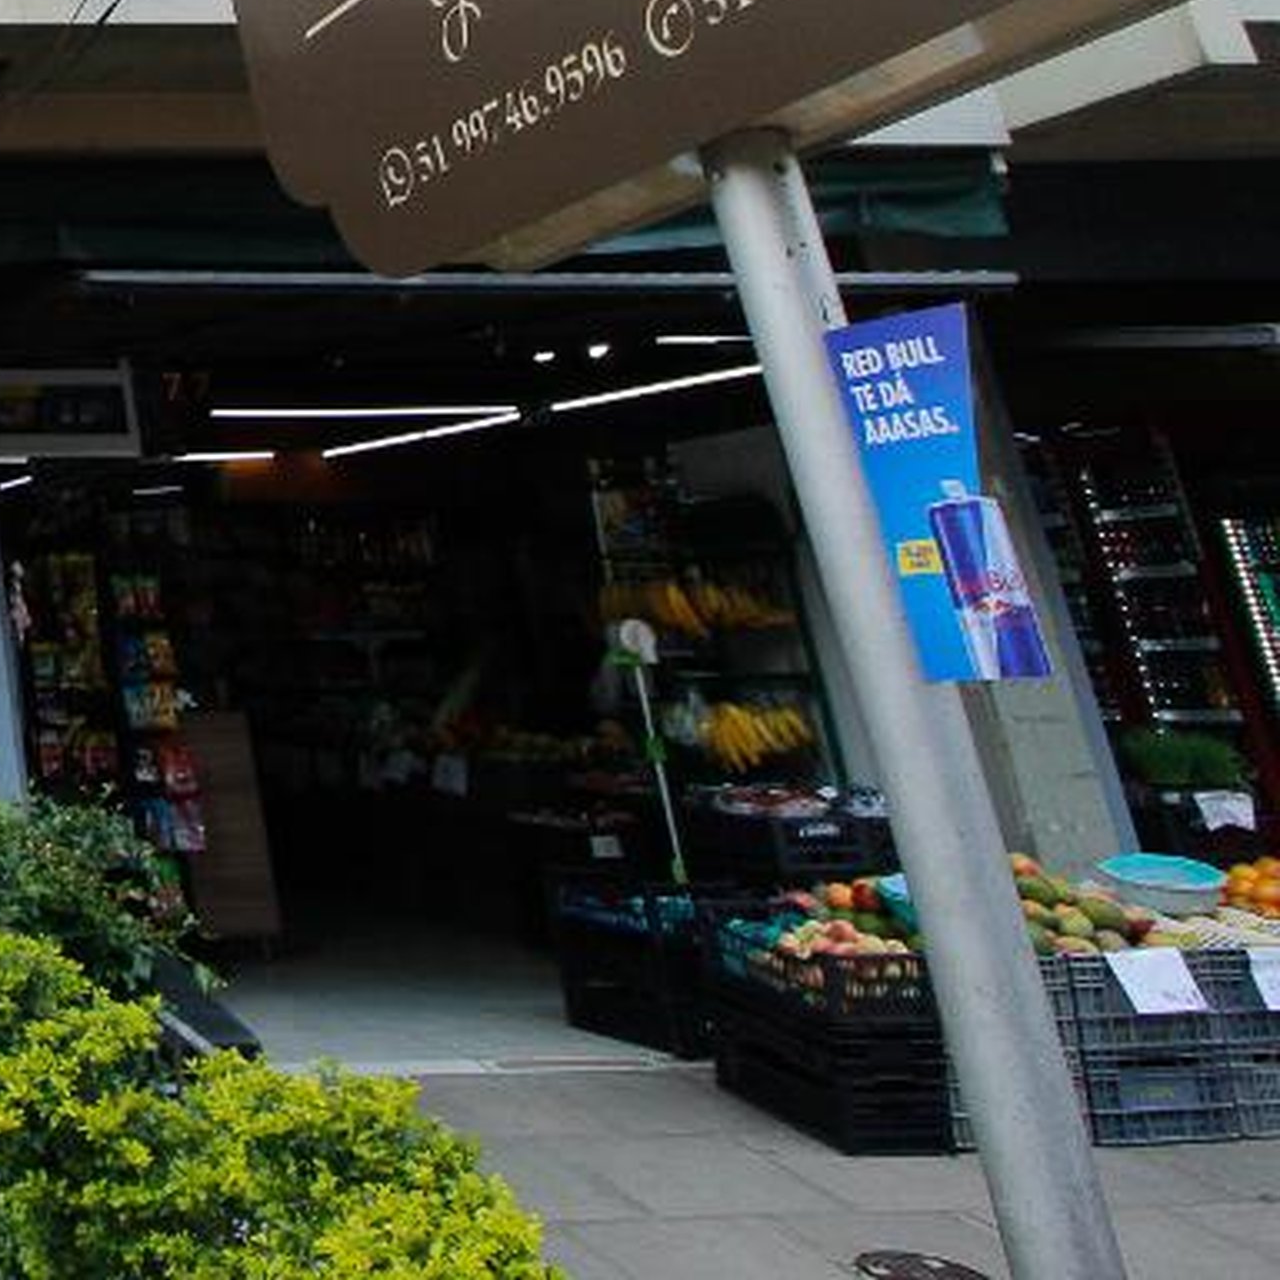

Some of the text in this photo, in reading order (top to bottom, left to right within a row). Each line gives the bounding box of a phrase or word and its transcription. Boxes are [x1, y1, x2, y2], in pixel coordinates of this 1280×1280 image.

[414, 132, 450, 182] 51
[452, 28, 628, 154] 99746.9596
[839, 335, 946, 379] RED BULL
[849, 372, 914, 413] TE DÁ
